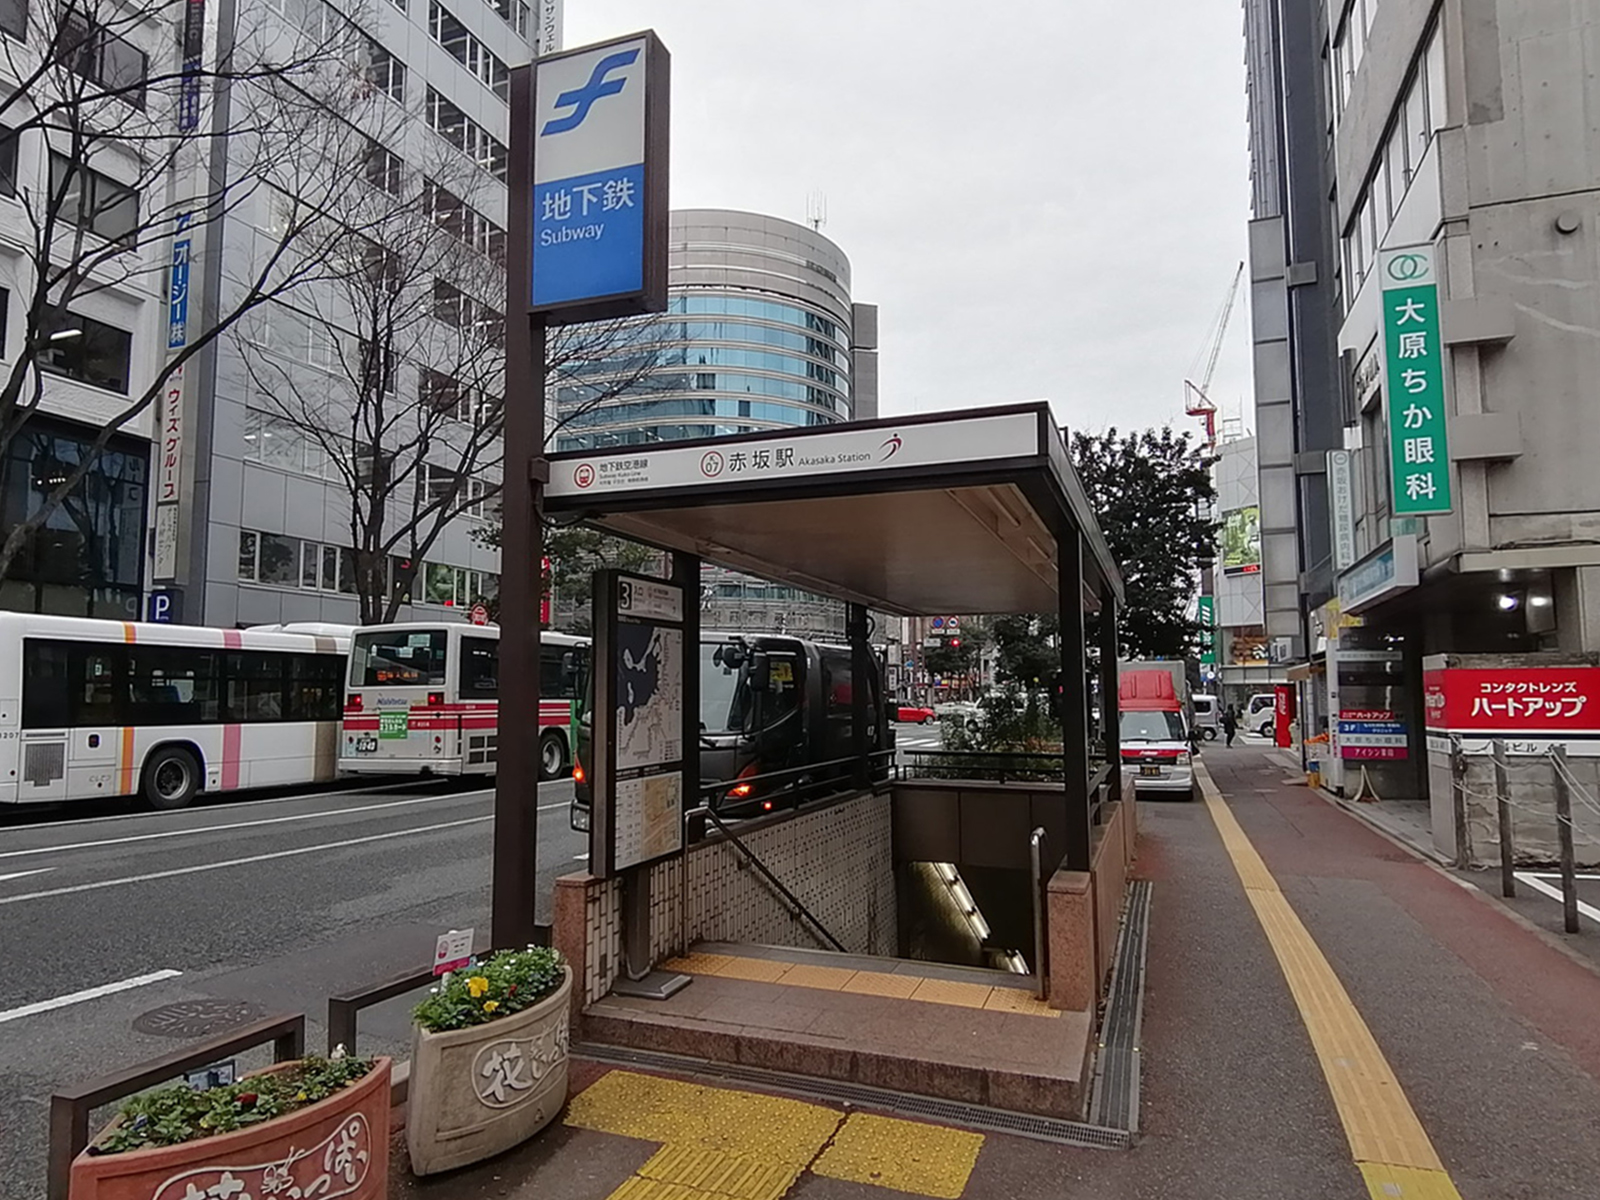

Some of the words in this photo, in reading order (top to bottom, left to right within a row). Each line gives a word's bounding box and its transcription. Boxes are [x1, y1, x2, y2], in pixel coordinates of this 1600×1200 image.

[541, 179, 635, 221] 地下鉄
[540, 222, 605, 247] Subway
[1395, 297, 1437, 500] 大原ちか眼科
[705, 462, 719, 473] 07
[729, 448, 794, 472] 赤坂駅
[798, 456, 836, 466] Akasaka
[837, 452, 871, 463] Station
[155, 595, 169, 619] P
[621, 583, 630, 608] 3
[1480, 682, 1577, 693] コンタクトレンズ
[1471, 695, 1587, 717] ハートアップ
